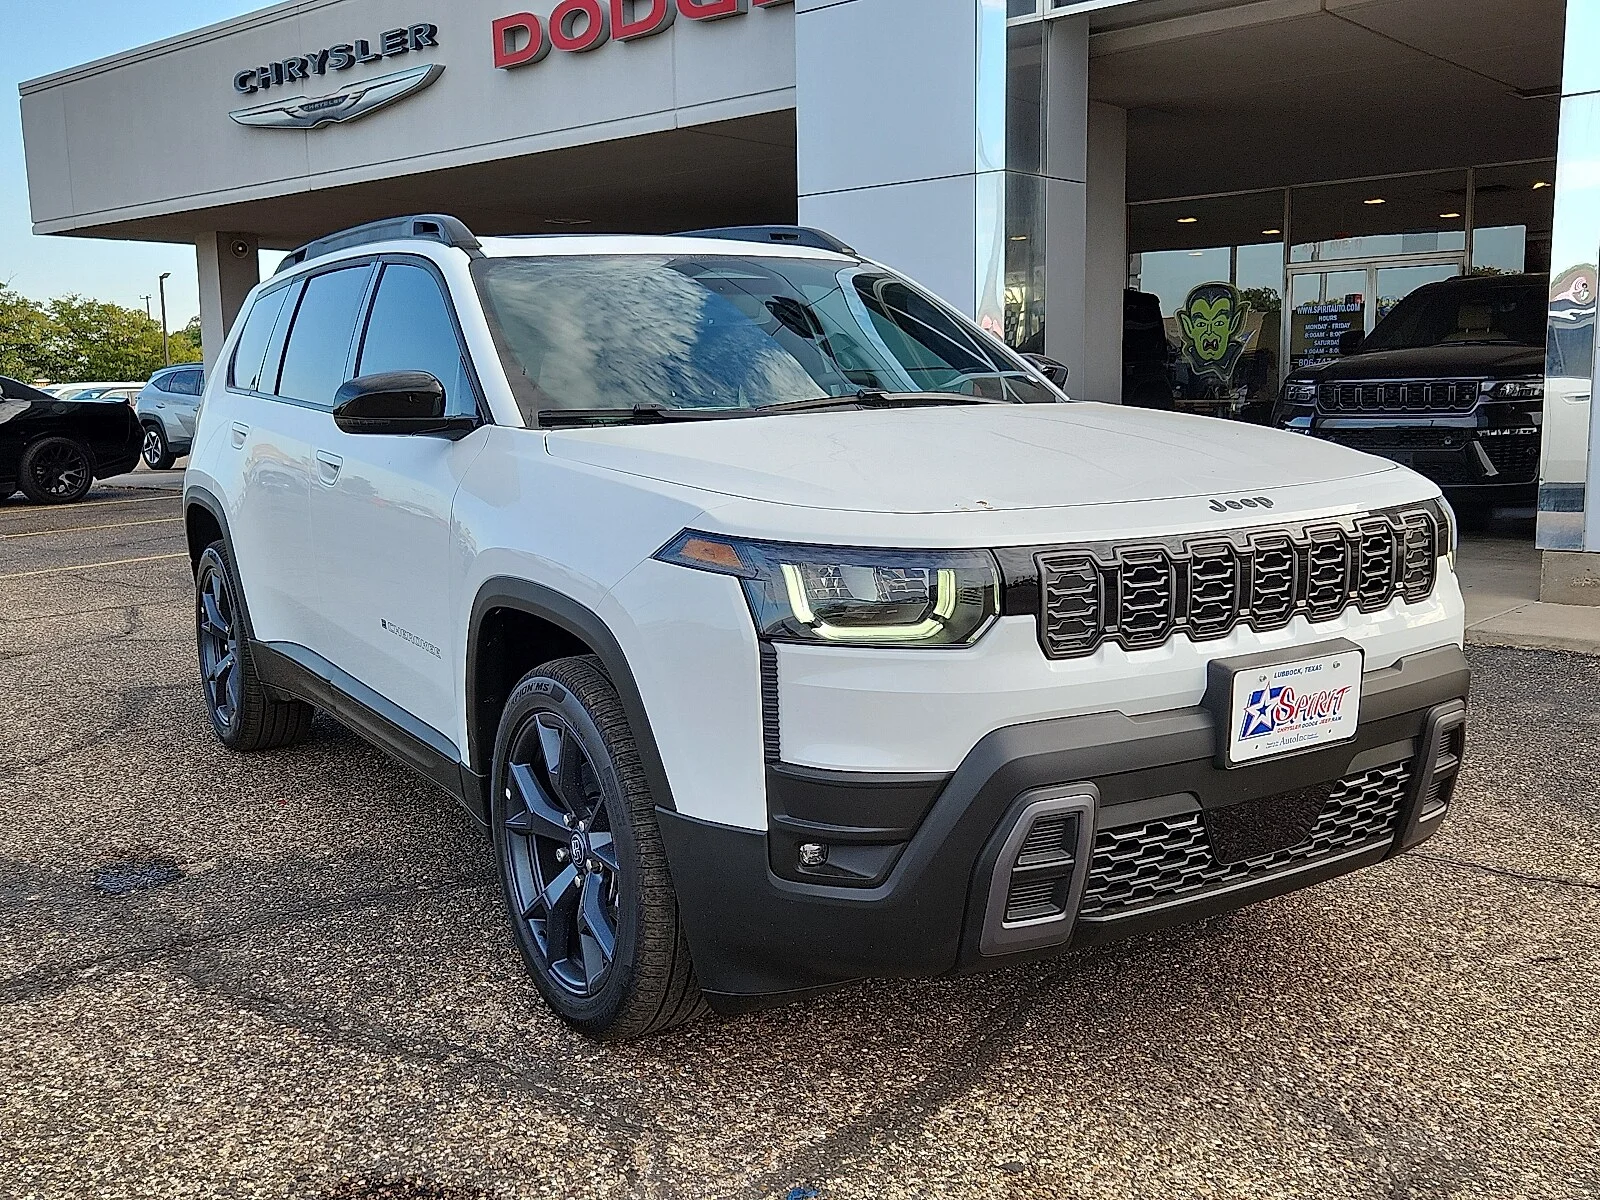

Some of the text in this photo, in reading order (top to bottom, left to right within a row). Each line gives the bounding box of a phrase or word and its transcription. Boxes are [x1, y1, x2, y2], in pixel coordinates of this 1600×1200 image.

[233, 22, 440, 95] CHRYSLER
[303, 97, 344, 112] CHRYSLER
[1297, 304, 1360, 315] WWW.SPIRITAUTO.COM
[1208, 496, 1274, 513] Jeep
[387, 621, 442, 660] CHEROKEE
[1273, 664, 1322, 679] LUBBOCK, TEXAS
[535, 682, 550, 692] MS
[1275, 686, 1352, 724] SPIRIT
[1277, 723, 1302, 733] CHRYSLER
[1302, 720, 1319, 729] DODGE
